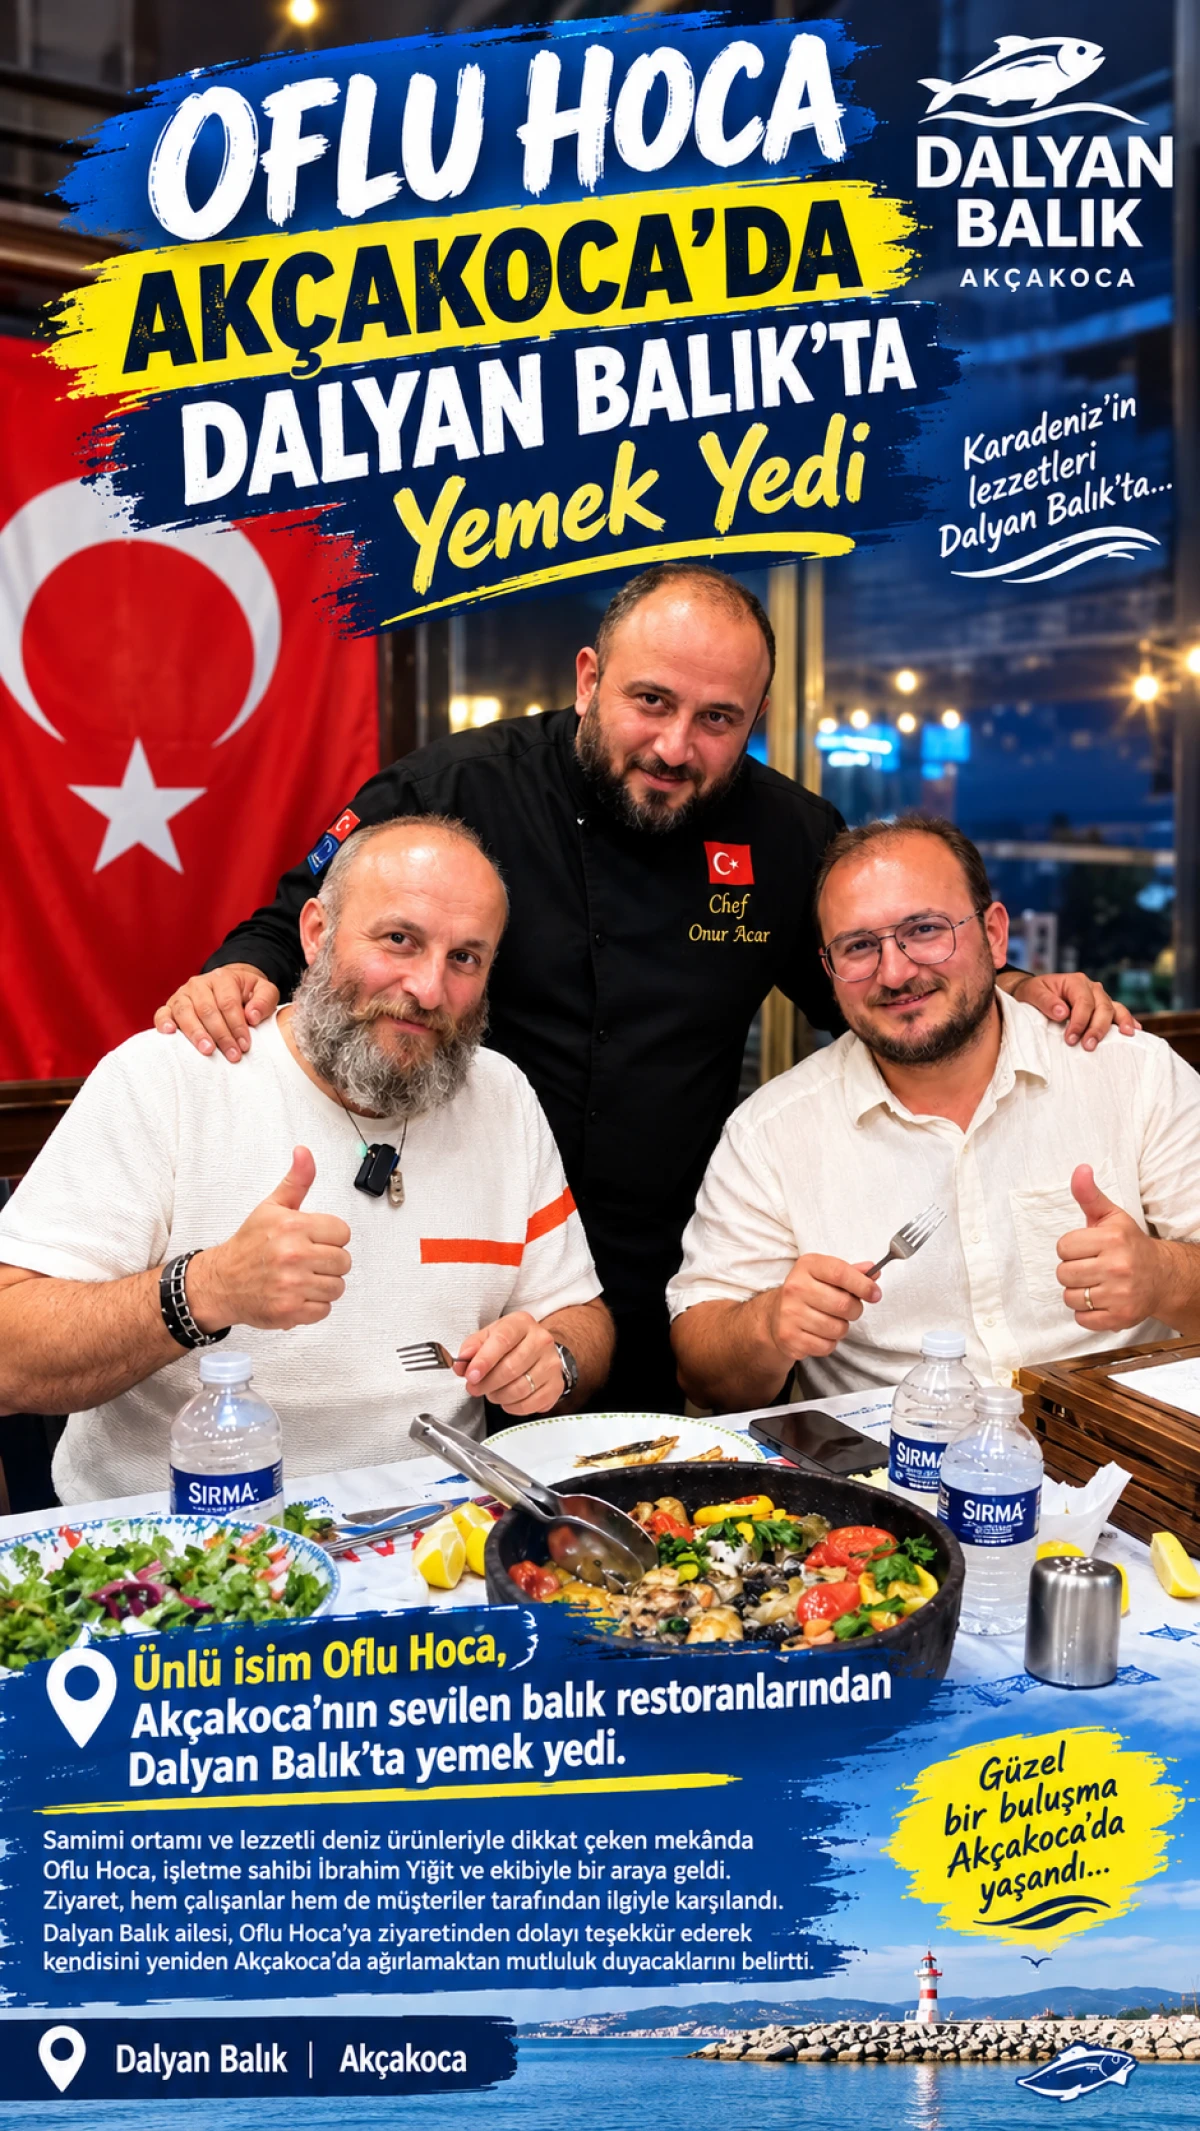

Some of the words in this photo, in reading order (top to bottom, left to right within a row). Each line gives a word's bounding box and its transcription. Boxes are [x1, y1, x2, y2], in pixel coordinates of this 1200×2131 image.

[708, 893, 751, 920] Chef
[688, 923, 729, 941] Onur
[733, 925, 771, 943] Acar
[188, 1482, 256, 1505] SIRMA
[962, 1499, 1024, 1523] SIRMA
